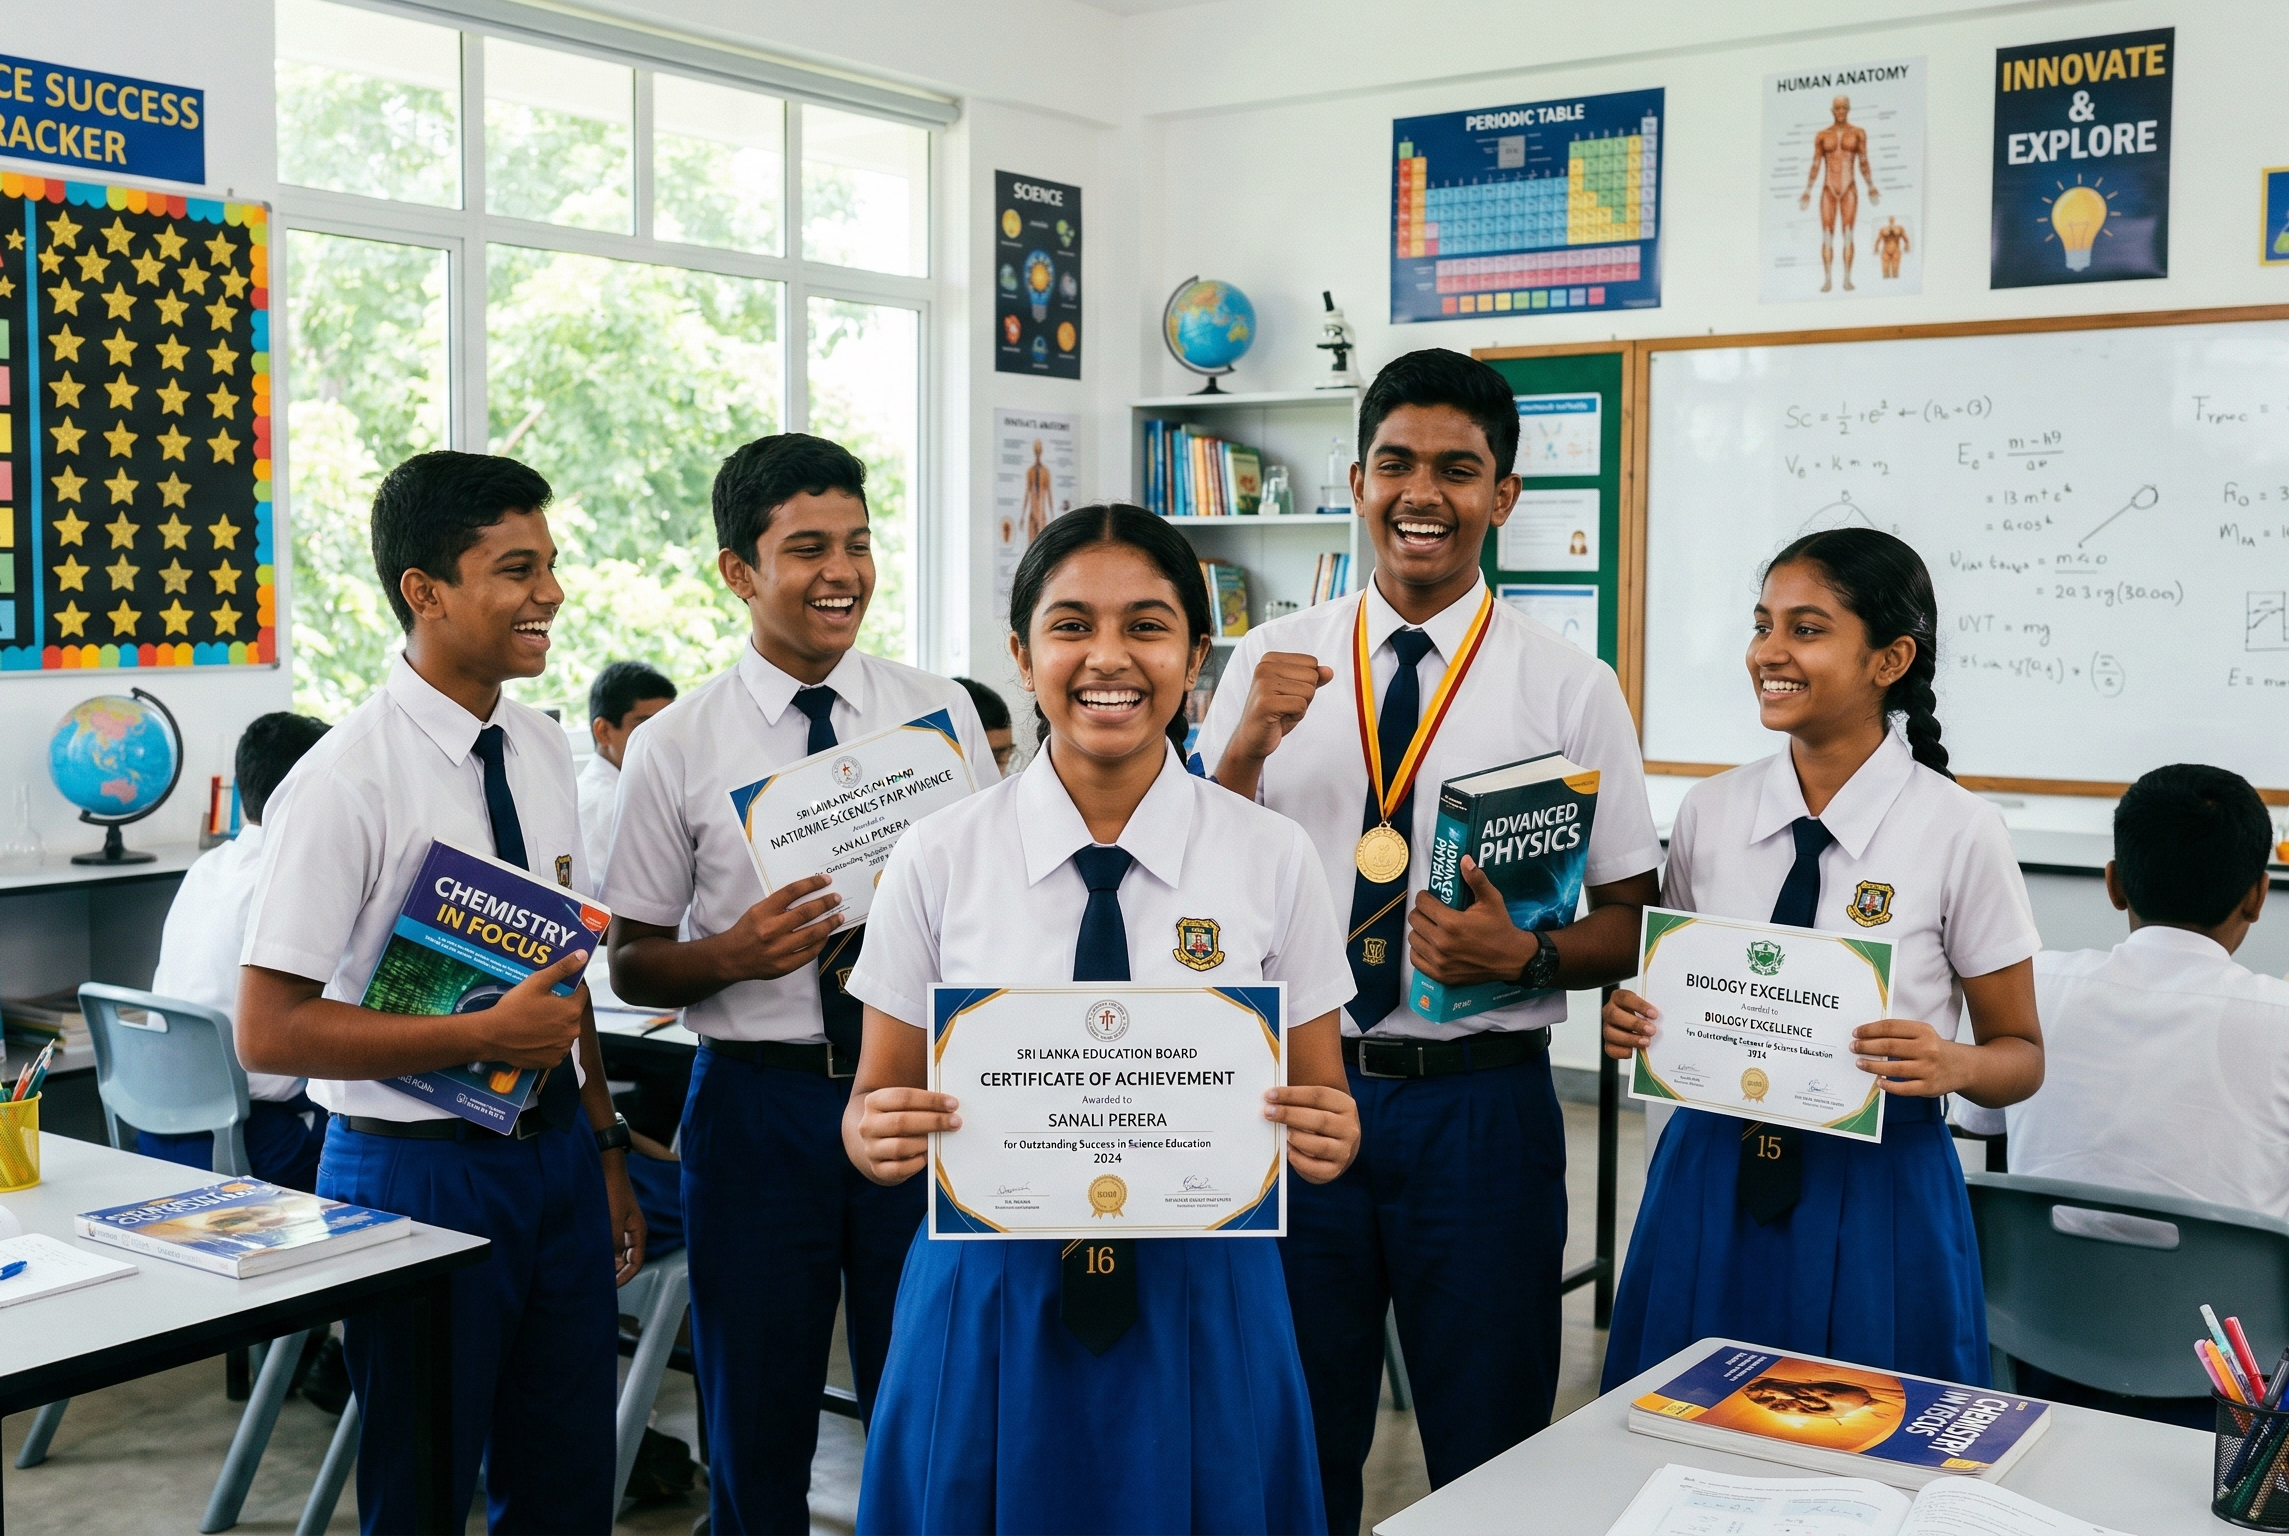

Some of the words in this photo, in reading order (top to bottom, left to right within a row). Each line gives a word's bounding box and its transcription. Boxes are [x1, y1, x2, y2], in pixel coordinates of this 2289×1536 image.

[1777, 74, 1831, 92] HUMAN
[1836, 65, 1909, 86] ANATOMY
[2003, 43, 2166, 92] INNOVATE
[45, 72, 199, 129] SUCCESS
[2068, 90, 2095, 122] &
[1466, 109, 1535, 131] PERIODIC
[1537, 104, 1585, 124] TABLE
[2008, 120, 2158, 165] EXPLORE
[1481, 802, 1579, 839] ADVANCED
[1478, 822, 1581, 869] PHYSICS
[434, 876, 577, 948] CHEMISTRY
[436, 903, 466, 929] IN
[466, 916, 552, 965] FOCUS
[1686, 973, 1747, 995] BIOLOGY
[1750, 983, 1840, 1009] EXCELLENCE
[1704, 1011, 1748, 1028] BIOLOGY
[1017, 1048, 1036, 1060] SRI
[1039, 1048, 1079, 1060] LANKA
[1082, 1048, 1152, 1059] EDUCATION
[1155, 1048, 1198, 1059] BOARD
[980, 1072, 1085, 1087] CERTIFICATE
[1089, 1072, 1111, 1086] OF
[1115, 1071, 1235, 1086] ACHIEVEMENT
[1081, 1095, 1121, 1104] Awarded
[1122, 1096, 1133, 1104] to
[1048, 1113, 1103, 1127] SANALI
[1109, 1113, 1167, 1127] PERERA
[1004, 1139, 1017, 1149] for
[1079, 1139, 1115, 1149] Success
[1117, 1139, 1126, 1148] in
[1165, 1139, 1211, 1148] Education
[1757, 1135, 1782, 1160] 15
[1093, 1153, 1122, 1164] 2024
[1086, 1246, 1115, 1274] 16
